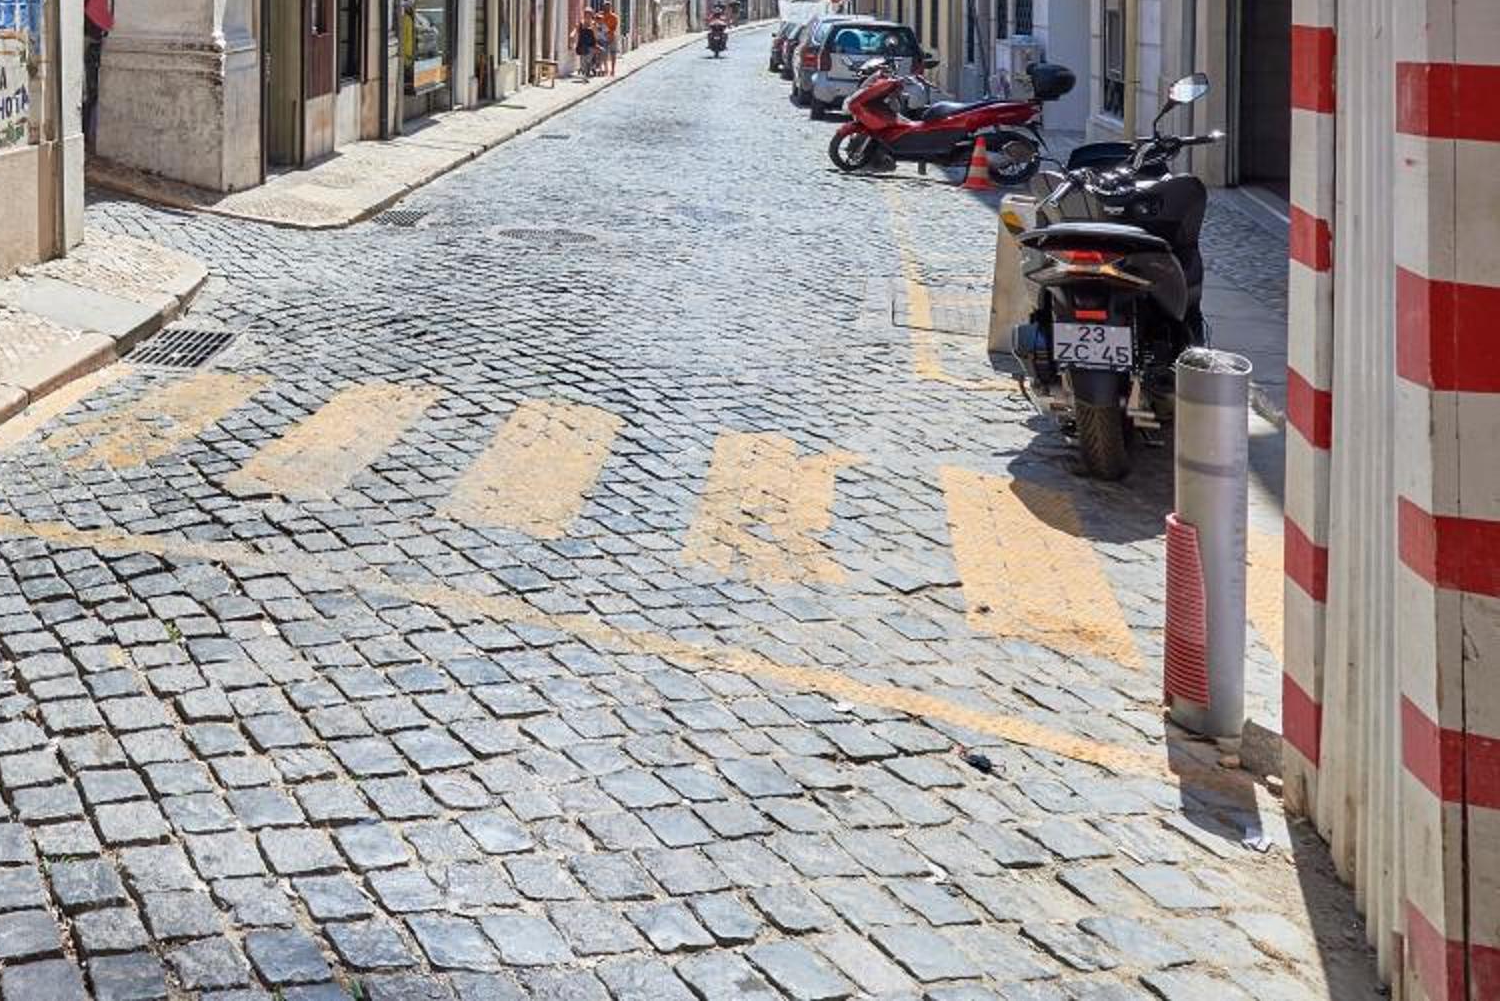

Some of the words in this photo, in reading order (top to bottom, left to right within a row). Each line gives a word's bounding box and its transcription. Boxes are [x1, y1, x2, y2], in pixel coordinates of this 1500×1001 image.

[0, 66, 8, 90] A
[1078, 326, 1105, 344] 23
[1056, 342, 1089, 360] ZC
[1101, 346, 1129, 365] 45
